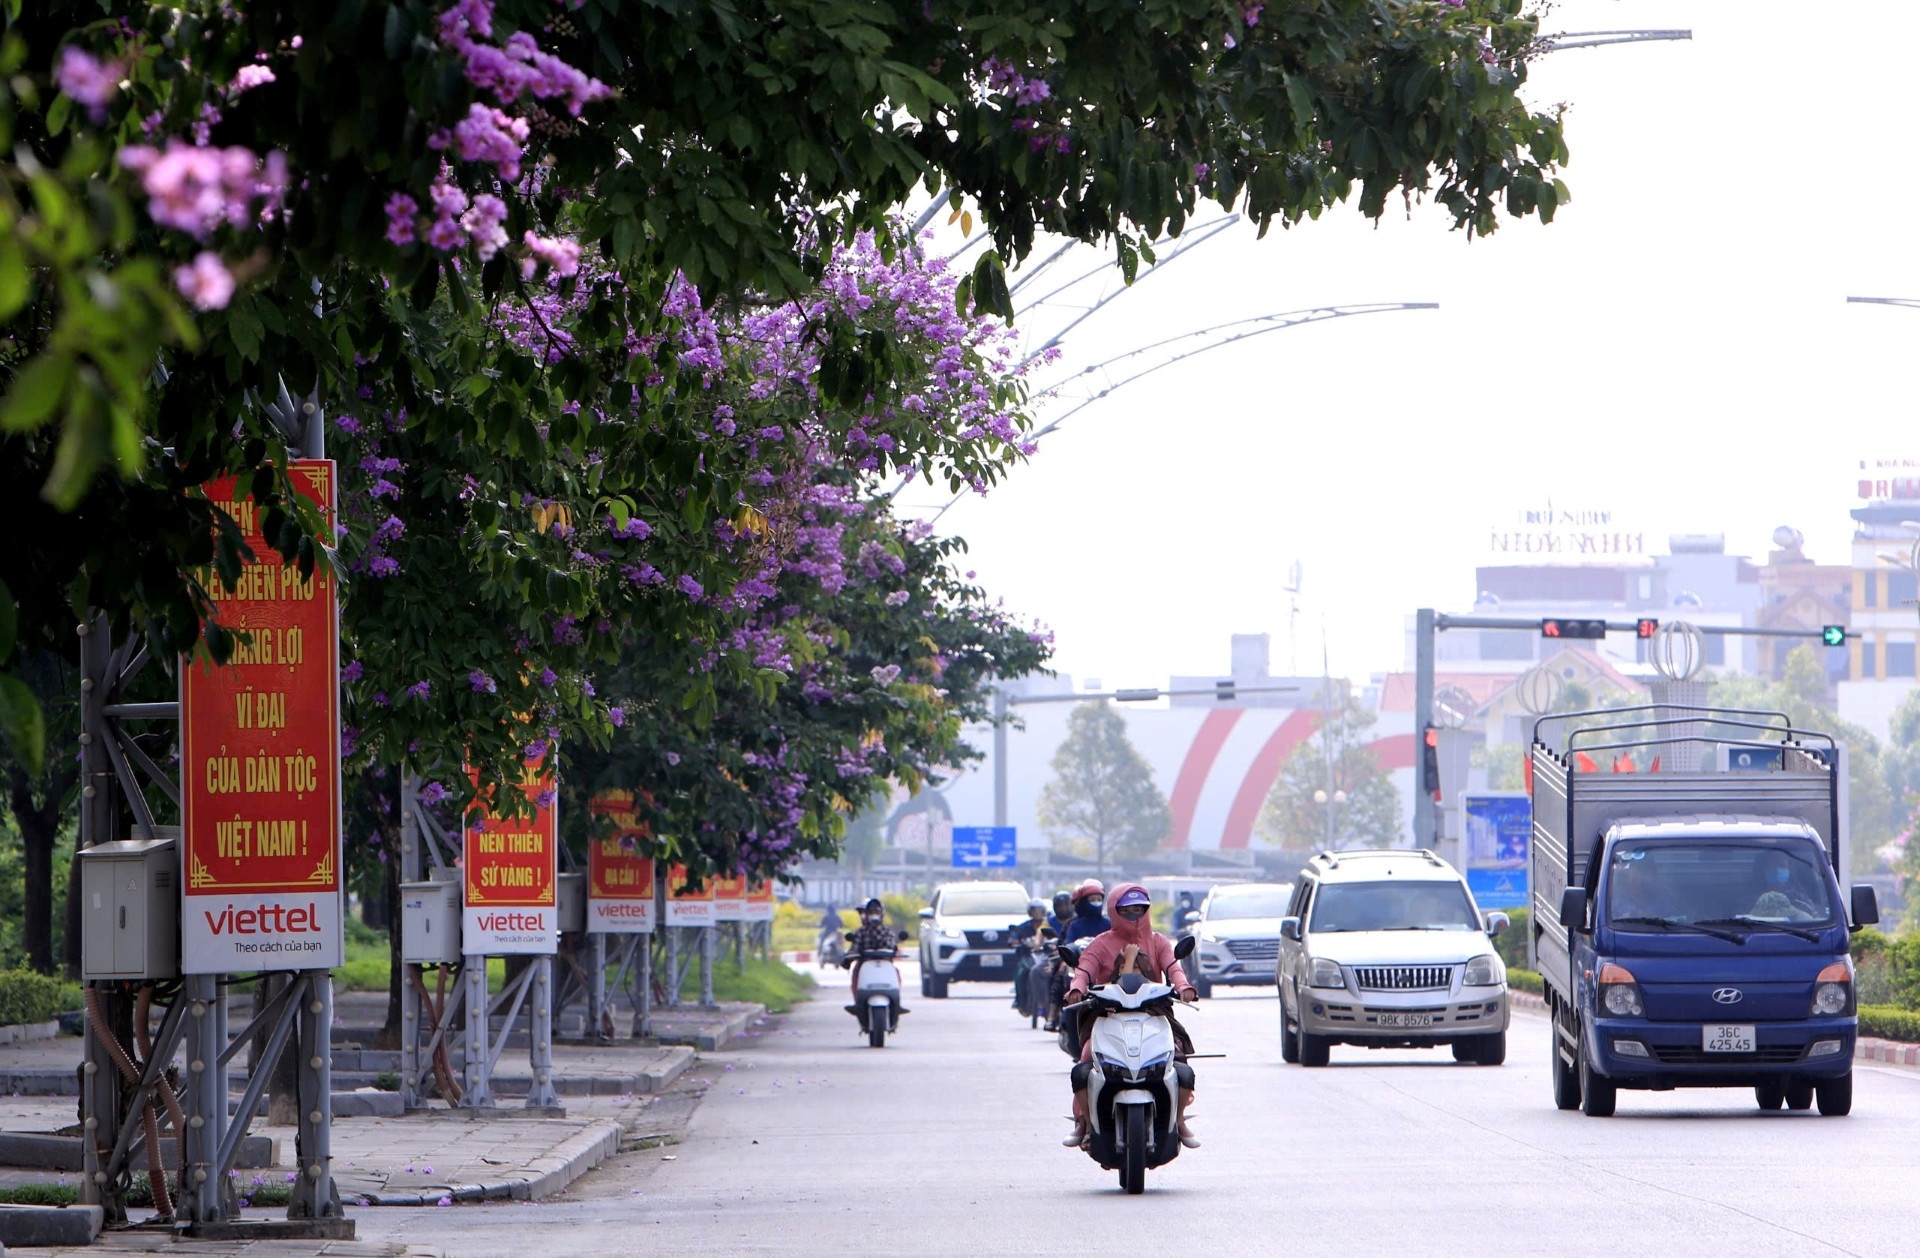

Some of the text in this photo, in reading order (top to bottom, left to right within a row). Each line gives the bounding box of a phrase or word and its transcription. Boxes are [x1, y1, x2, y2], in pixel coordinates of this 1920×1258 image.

[236, 556, 276, 601] BIÊN
[277, 625, 303, 673] LỢI
[235, 685, 286, 737] VĨ ĐẠI
[206, 744, 317, 801] CỦA DÂN TỘC
[216, 813, 252, 867] VIỆT
[256, 820, 296, 857] NAM
[479, 829, 543, 854] NÊN THIÊN
[481, 860, 499, 887] SỬ
[500, 863, 534, 887] VÀNG
[204, 902, 321, 935] viettel
[477, 912, 545, 931] viettel
[597, 903, 647, 917] viettel
[234, 940, 322, 953] Theo cách của bạn
[1709, 1039, 1751, 1051] 425.45
[1717, 1027, 1741, 1039] 36C
